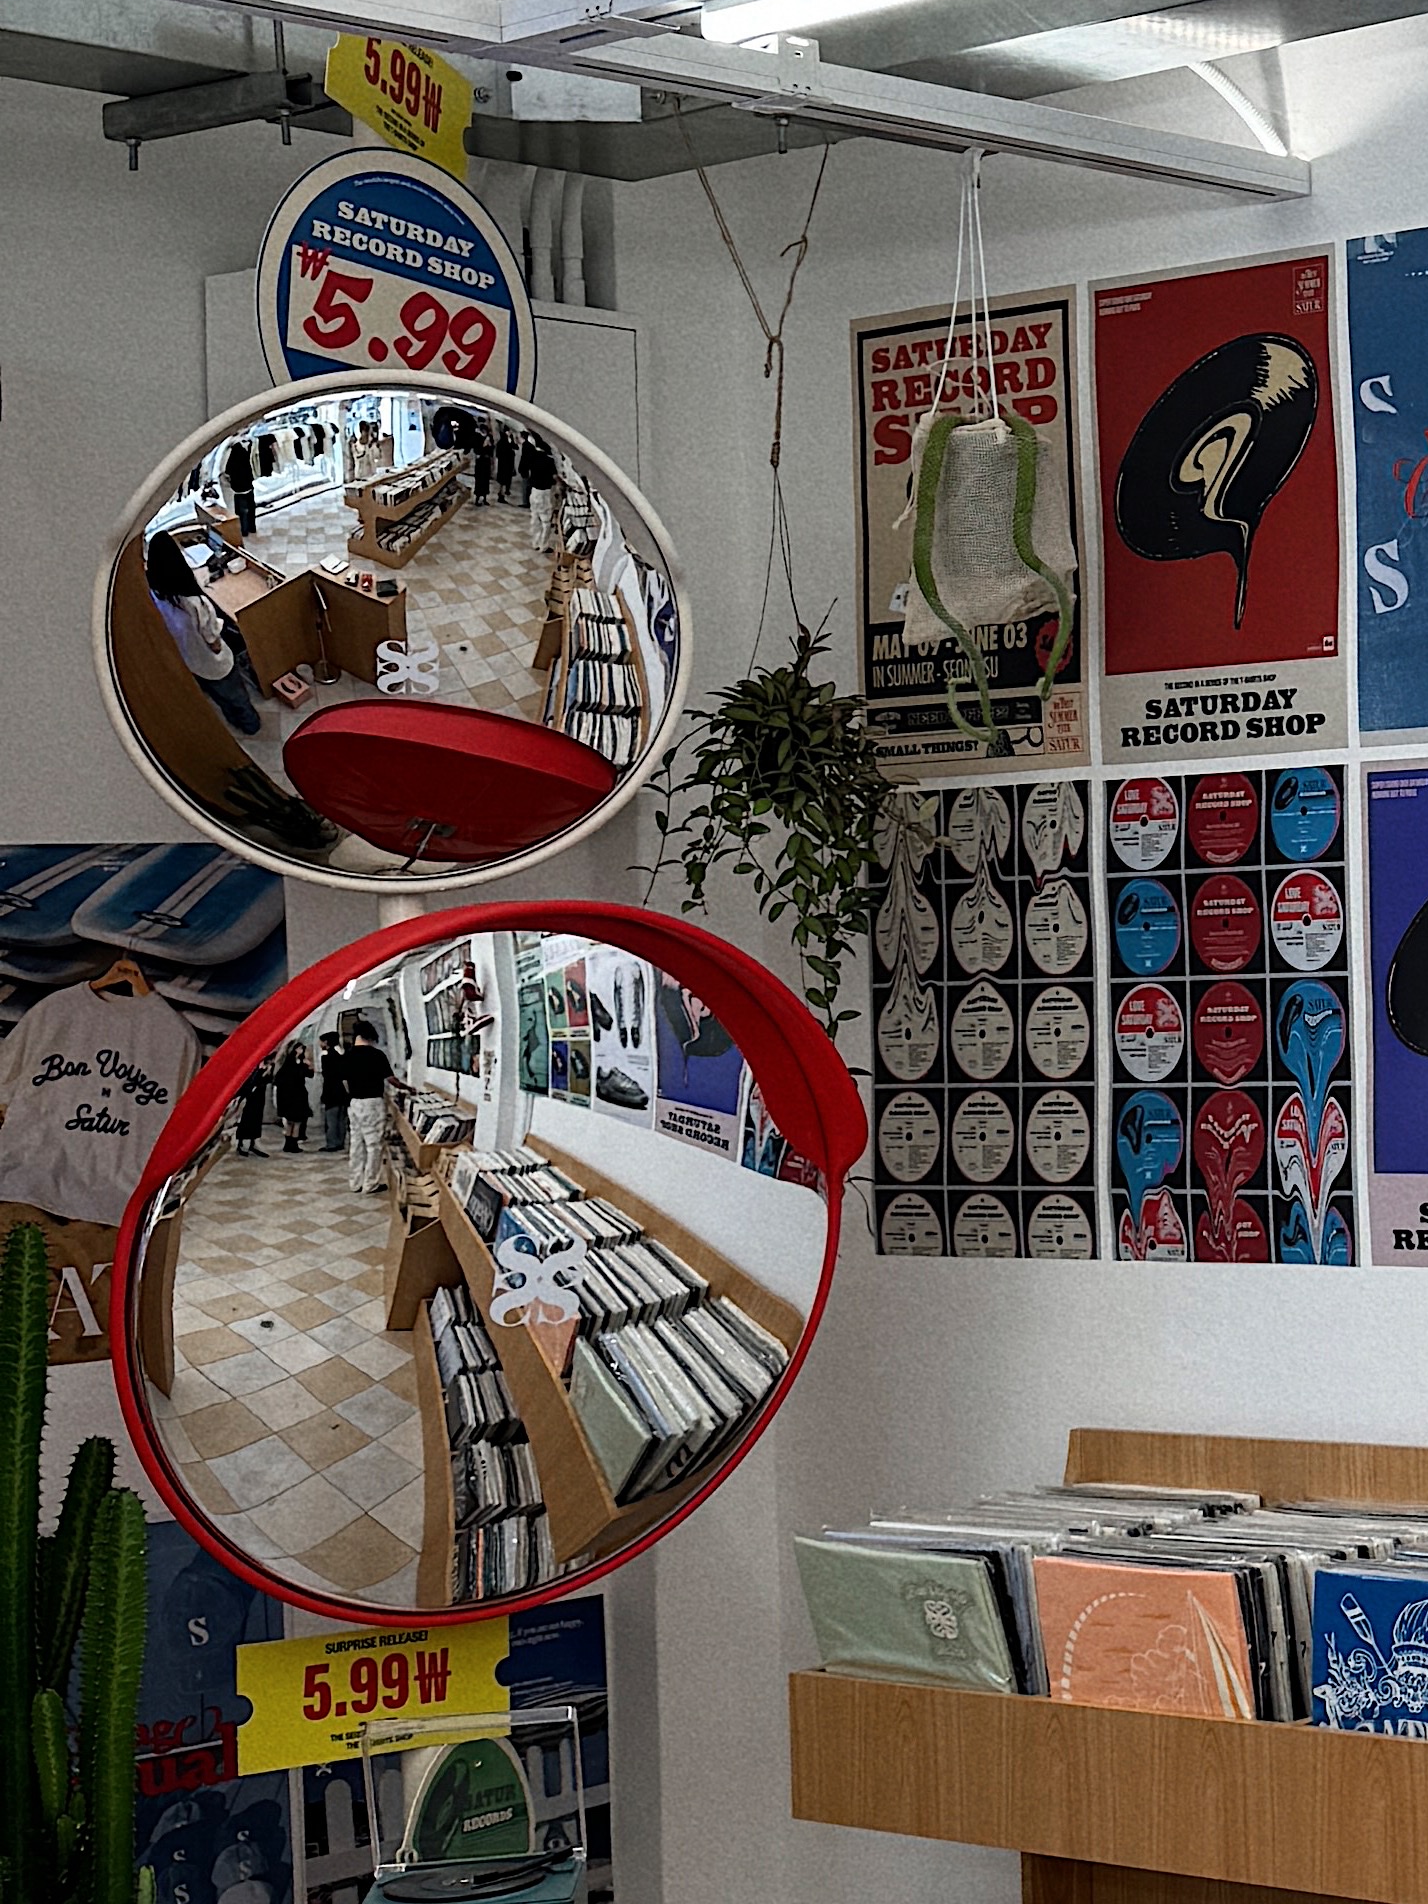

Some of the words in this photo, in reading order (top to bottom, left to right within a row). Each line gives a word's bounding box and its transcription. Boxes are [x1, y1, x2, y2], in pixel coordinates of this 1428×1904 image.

[338, 200, 475, 258] SATURDAY
[312, 220, 423, 268] RECORD
[428, 257, 495, 289] SHOP
[872, 323, 1052, 373] SATURDAY
[871, 357, 1056, 412] RECORD
[1003, 622, 1027, 649] 03
[872, 663, 884, 688] IN
[887, 662, 935, 687] SUMMER
[1145, 688, 1298, 719] SATURDAY
[1121, 720, 1241, 747] RECORD
[1246, 713, 1326, 738] SHOP
[875, 742, 921, 758] SMALL
[924, 740, 979, 754] THINGS?
[32, 1053, 92, 1087] Bon
[64, 1103, 131, 1137] Satur
[188, 1616, 210, 1647] S
[324, 1637, 377, 1655] SURPRISE
[378, 1630, 429, 1650] RELEASE!
[462, 1807, 513, 1834] RECORDS
